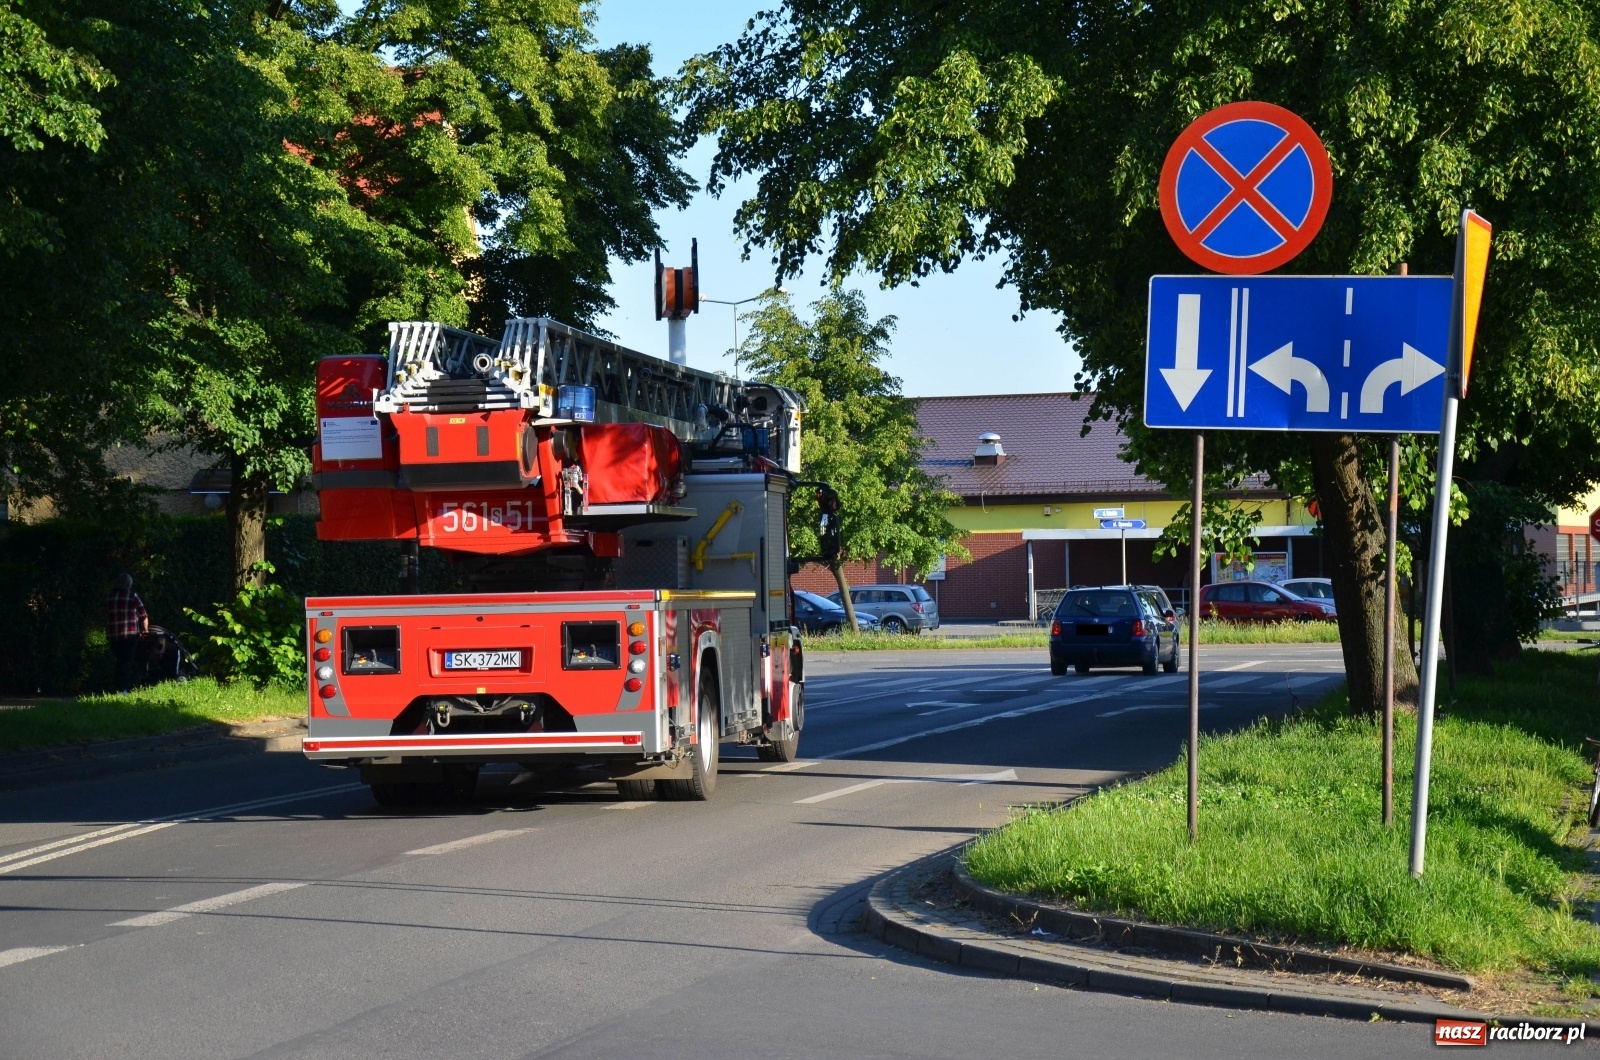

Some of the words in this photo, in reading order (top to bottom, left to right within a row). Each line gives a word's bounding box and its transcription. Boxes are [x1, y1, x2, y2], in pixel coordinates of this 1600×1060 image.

[442, 501, 488, 532] 561
[492, 508, 502, 525] S
[506, 501, 533, 531] 51
[454, 653, 472, 666] SK
[478, 652, 517, 666] 372MK
